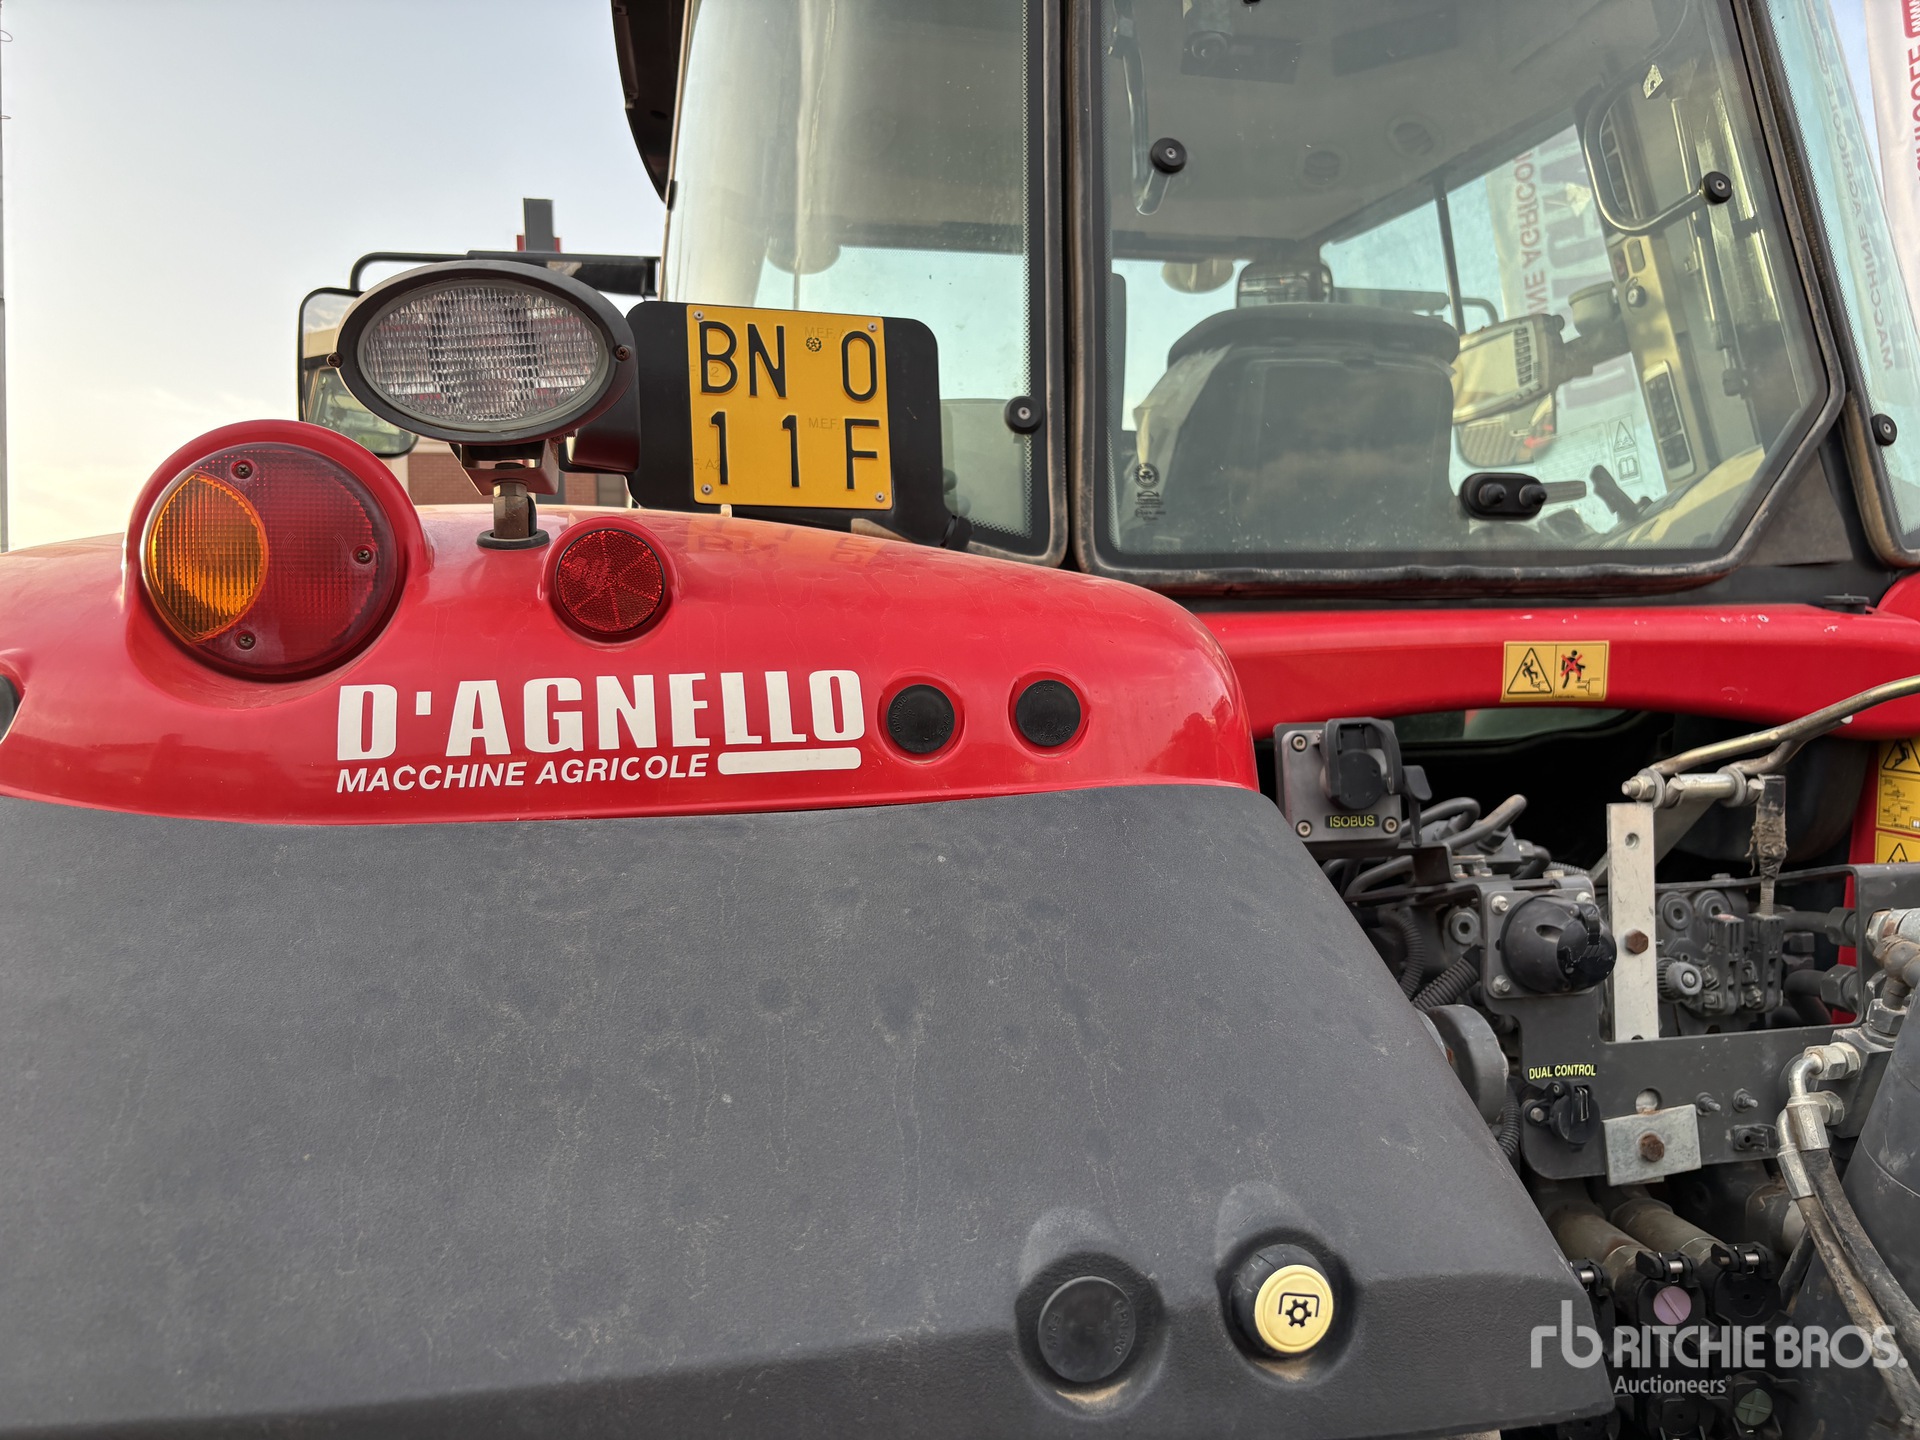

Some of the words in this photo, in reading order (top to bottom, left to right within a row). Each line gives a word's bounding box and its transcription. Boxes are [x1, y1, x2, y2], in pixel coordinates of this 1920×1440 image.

[699, 320, 787, 398] BN
[336, 669, 866, 761] D'AGNELLO
[336, 762, 525, 793] MACCHINE
[535, 753, 709, 785] AGRICOLE
[1329, 815, 1375, 828] ISOBUS
[1528, 1066, 1553, 1080] DUAL
[1555, 1064, 1597, 1078] CONTROL
